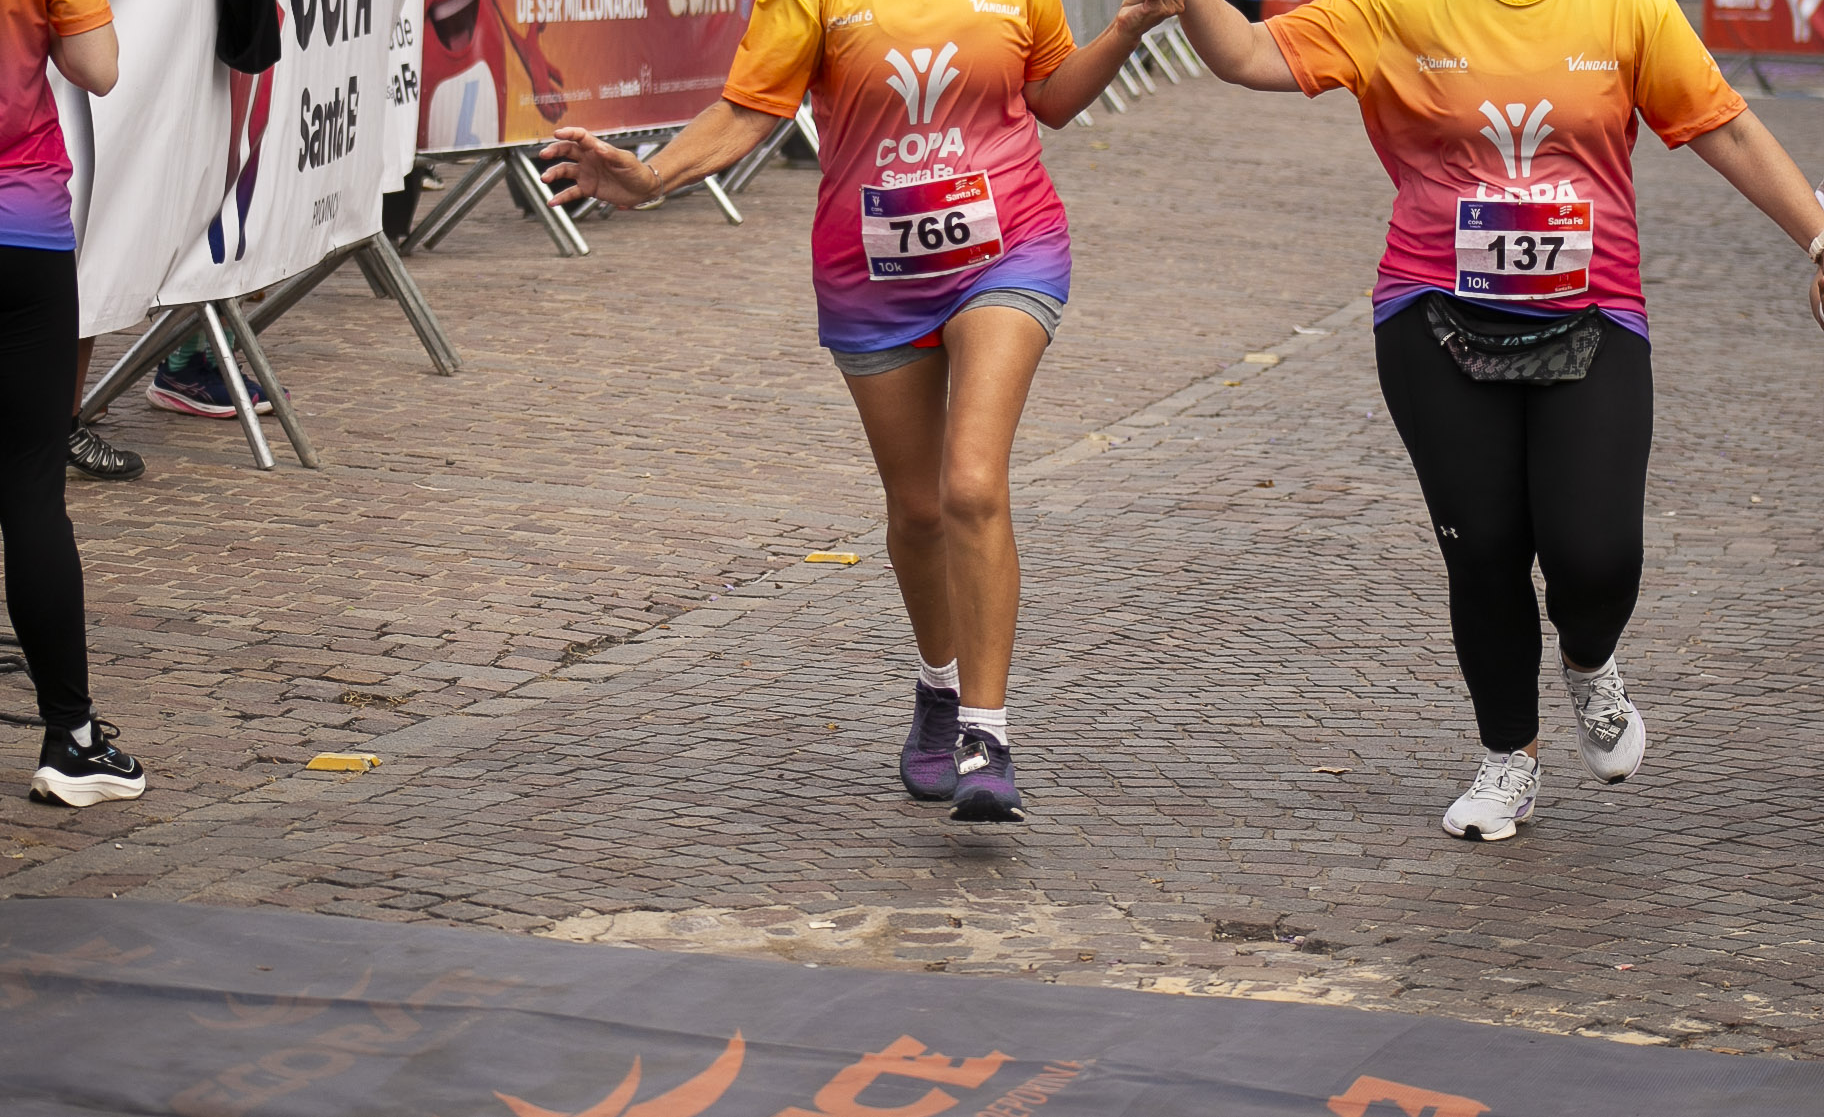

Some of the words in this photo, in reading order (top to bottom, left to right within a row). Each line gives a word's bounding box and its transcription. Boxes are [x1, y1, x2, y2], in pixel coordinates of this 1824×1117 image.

[864, 8, 873, 22] 6
[395, 18, 413, 49] de
[1459, 56, 1468, 69] 6
[1564, 51, 1619, 72] VANDALI
[298, 86, 345, 173] Santa
[876, 127, 965, 167] COPA
[881, 168, 931, 188] Santa
[933, 164, 954, 179] Fe
[945, 191, 971, 202] Santa
[970, 188, 982, 197] Fe
[1548, 217, 1573, 226] Santa
[1573, 216, 1584, 225] Fe
[889, 211, 971, 254] 766
[1487, 235, 1565, 271] 137
[878, 261, 902, 273] 10k
[1467, 277, 1490, 290] 10k
